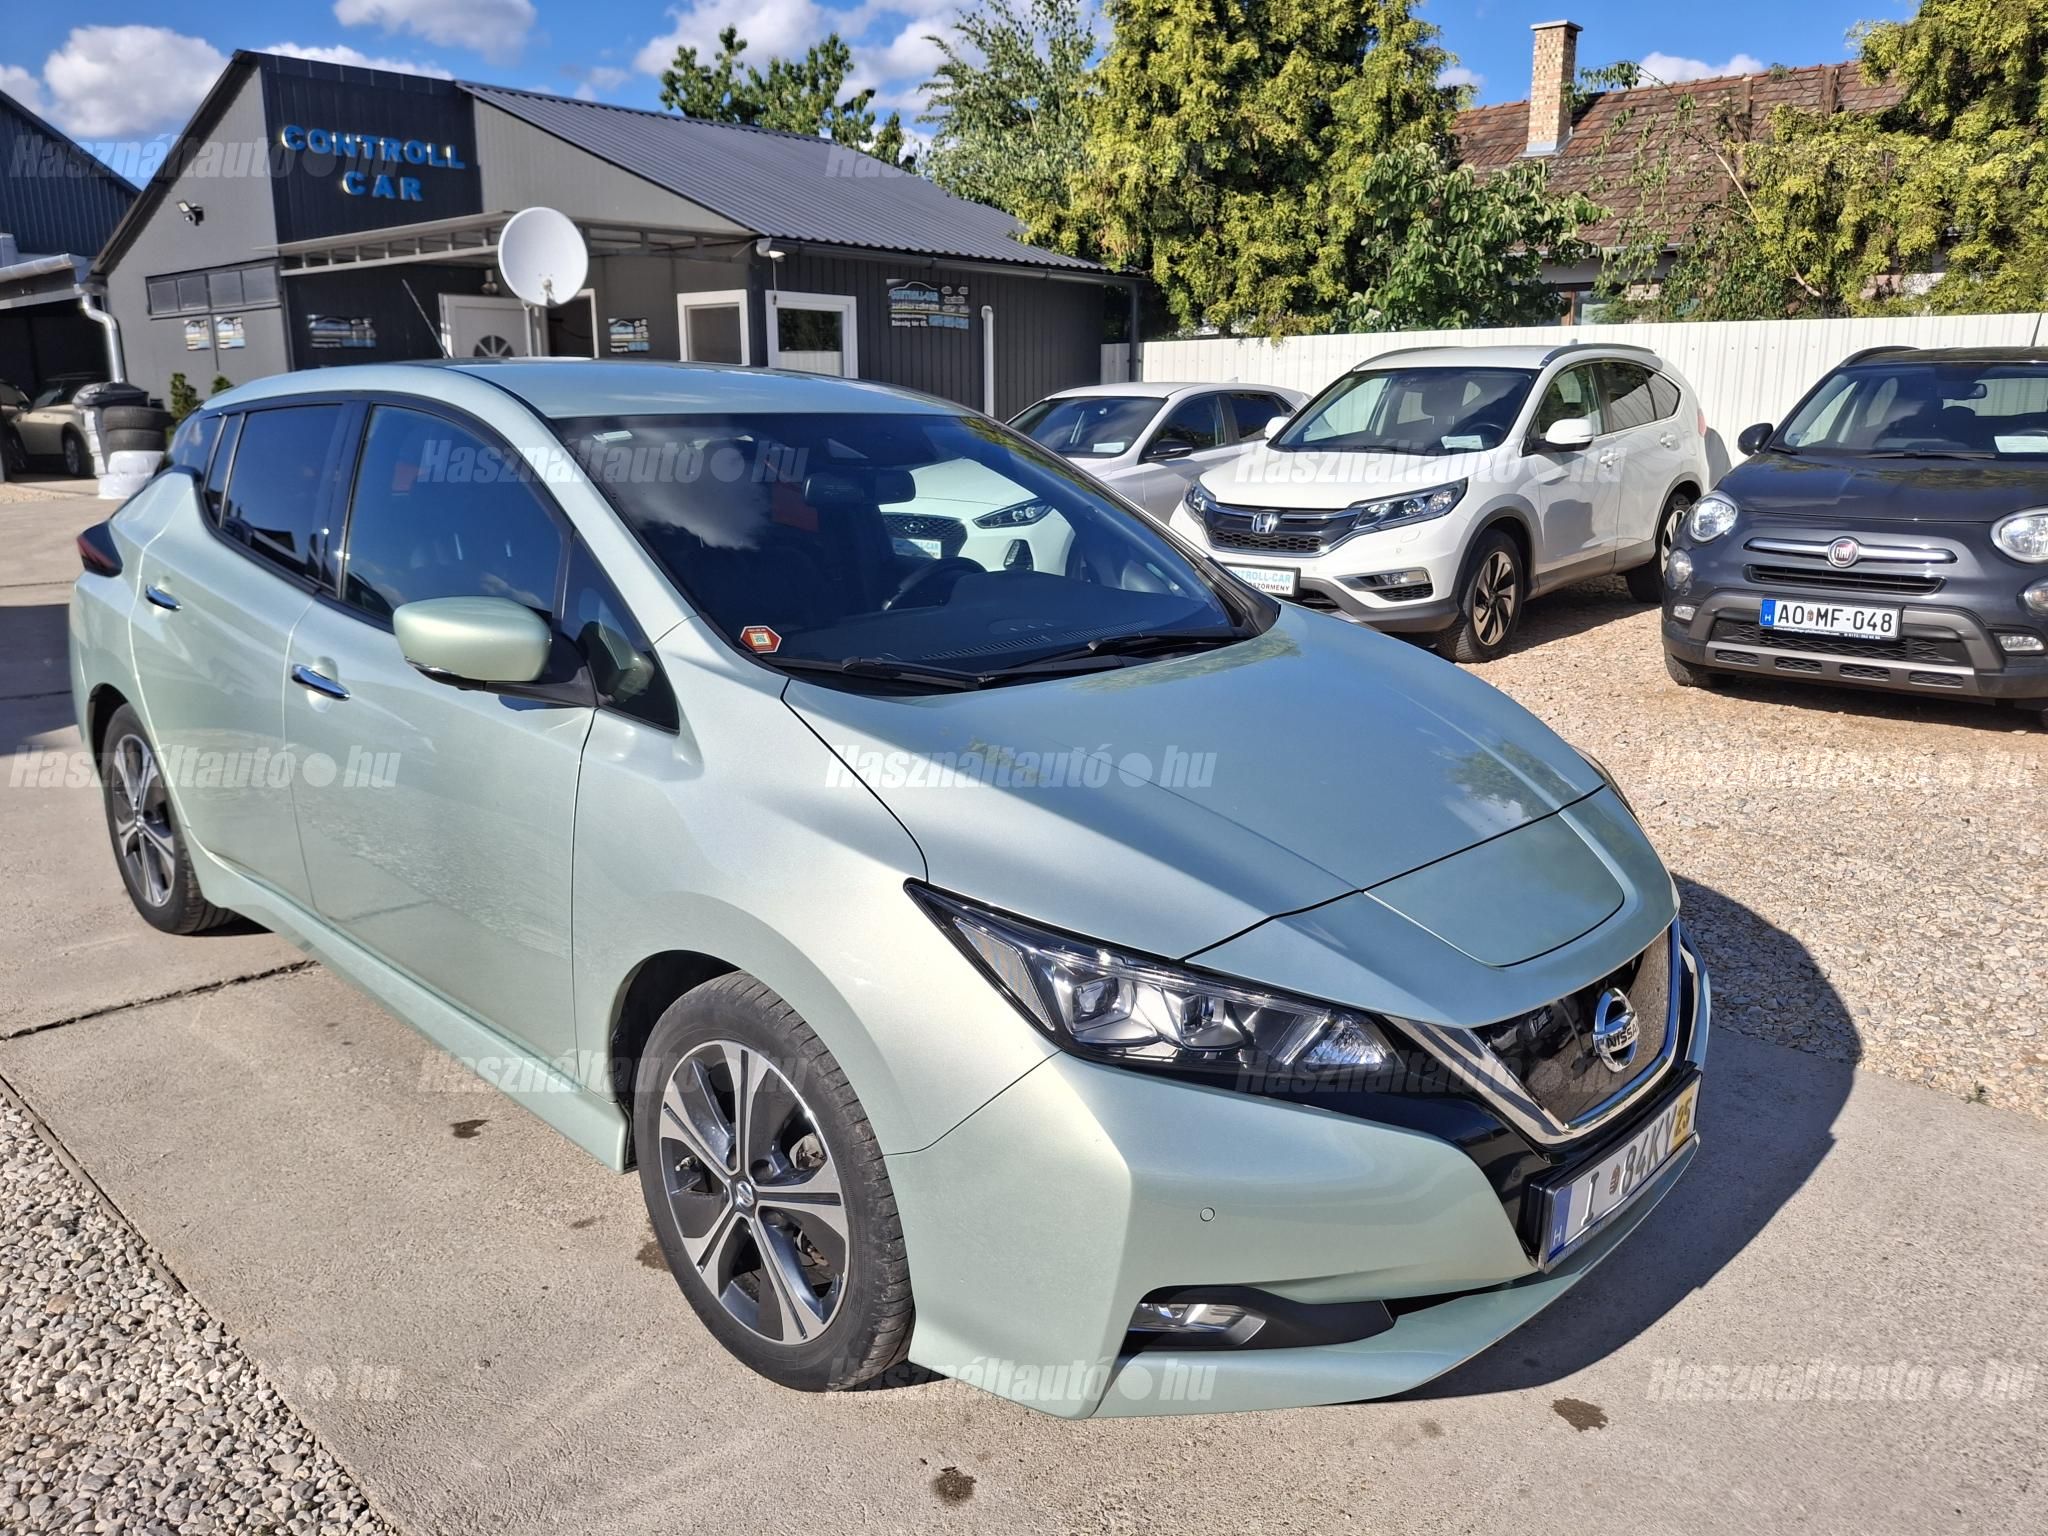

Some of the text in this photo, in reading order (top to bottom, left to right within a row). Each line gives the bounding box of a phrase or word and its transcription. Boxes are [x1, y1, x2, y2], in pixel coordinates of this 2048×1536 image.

[281, 124, 466, 169] CONTROLL
[342, 170, 424, 201] CAR
[1778, 604, 1805, 625] AO
[1815, 607, 1893, 633] MF-048
[1606, 1023, 1639, 1049] NISSA
